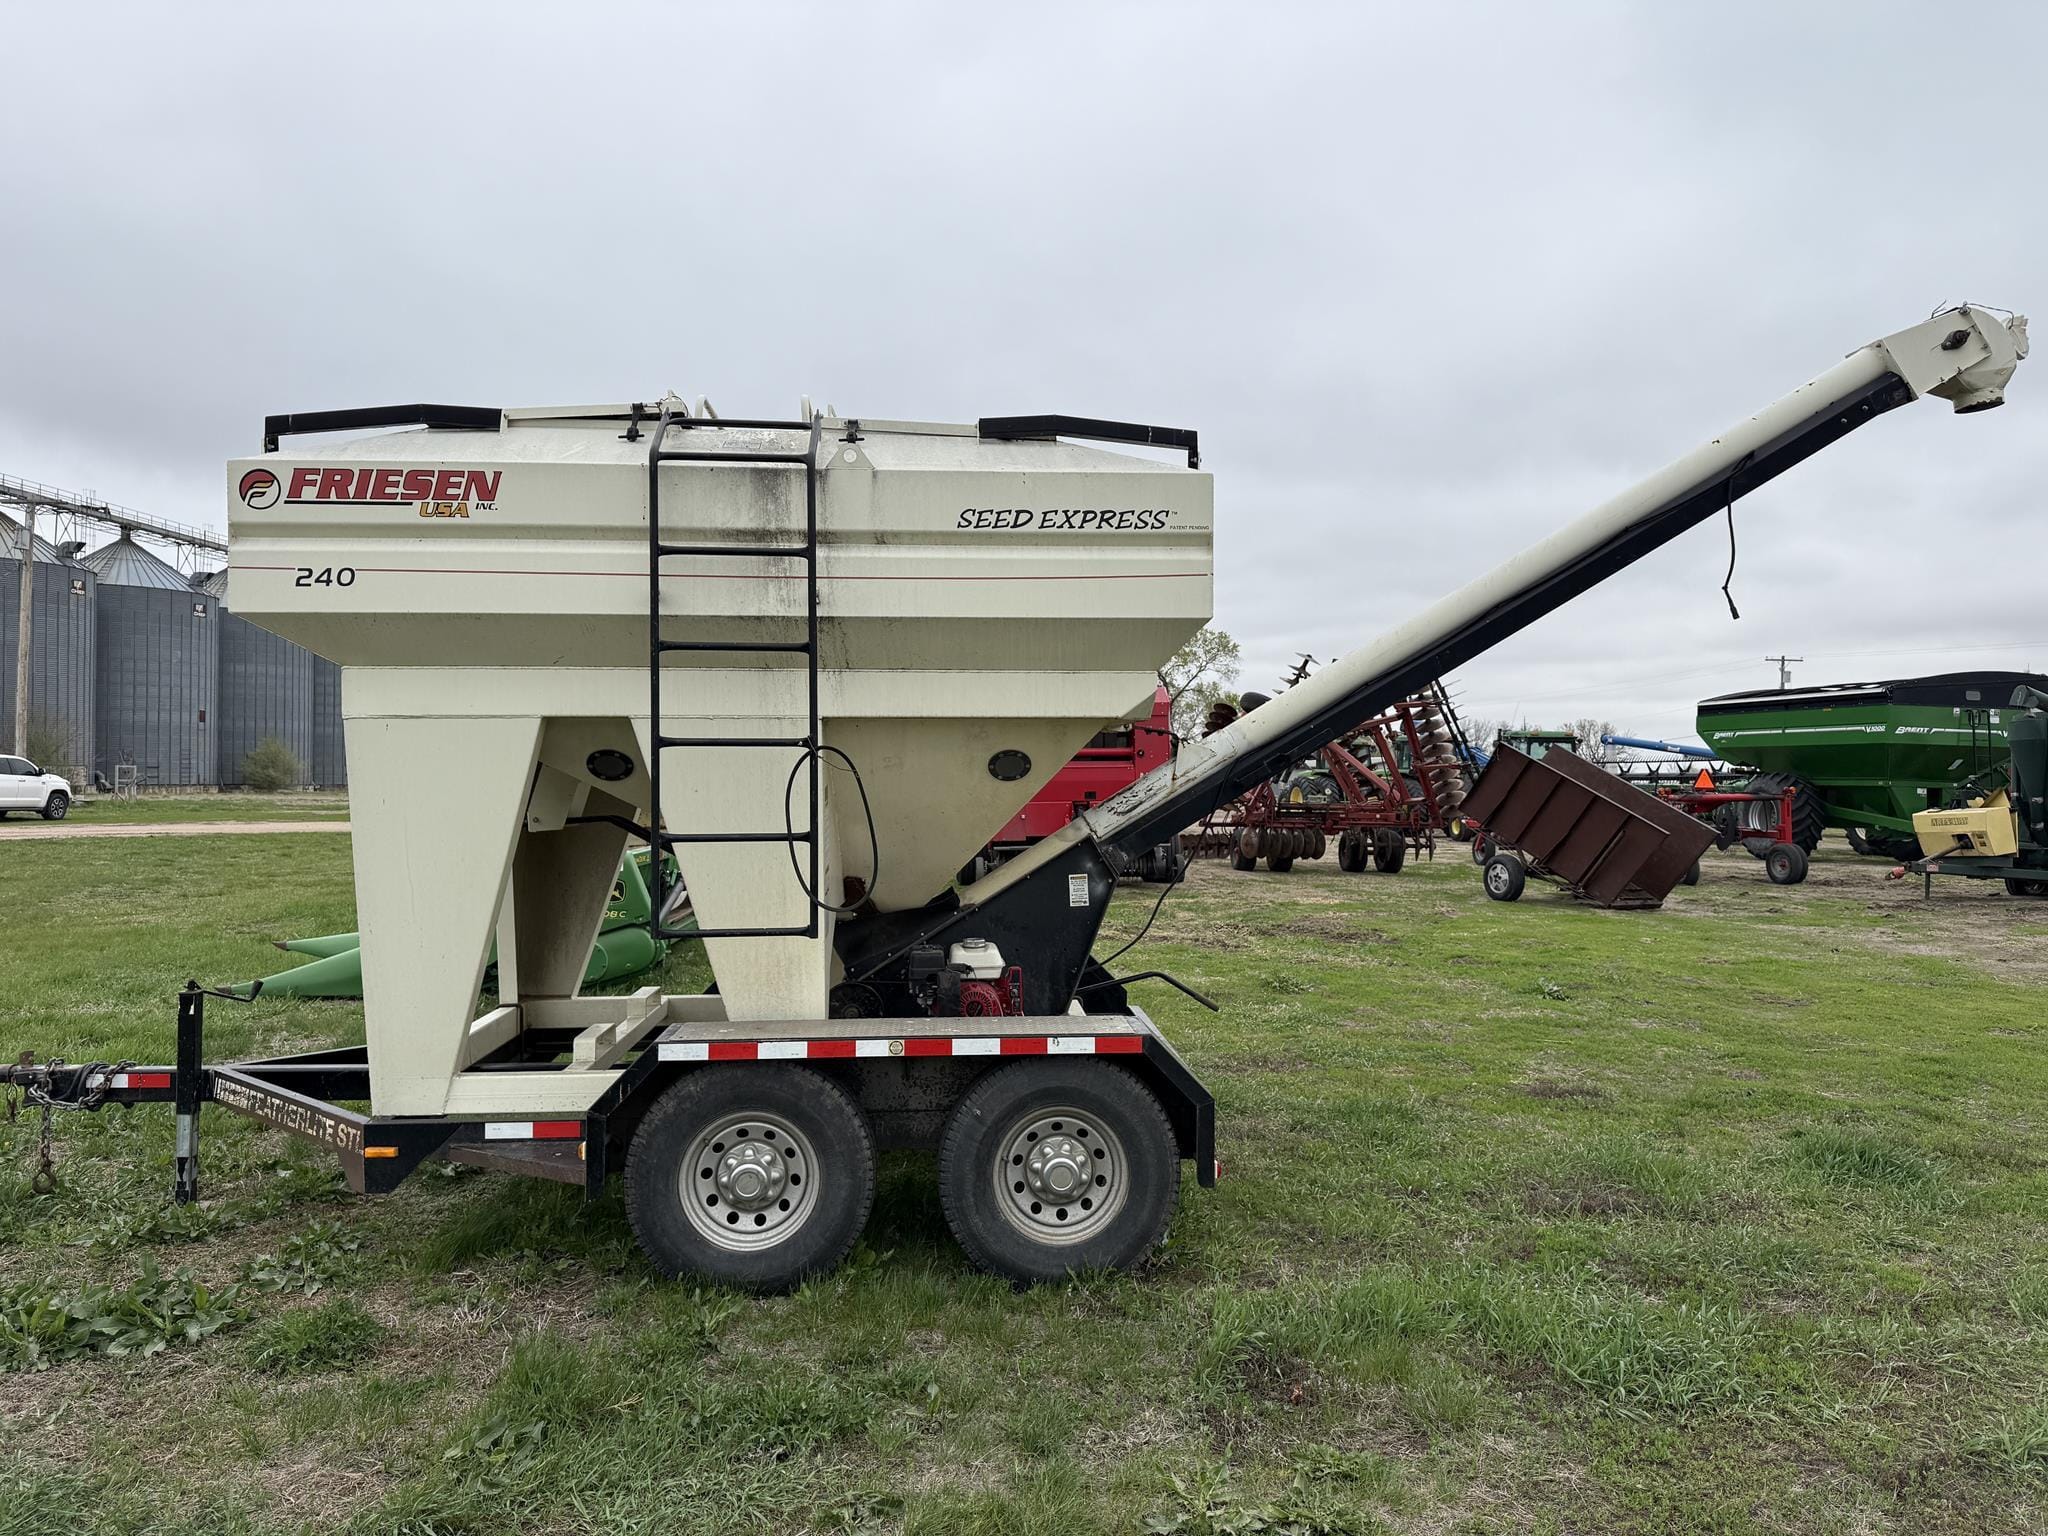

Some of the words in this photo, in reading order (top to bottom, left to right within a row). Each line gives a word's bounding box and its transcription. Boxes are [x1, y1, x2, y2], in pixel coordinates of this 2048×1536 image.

[286, 467, 502, 501] FRIESEN
[419, 501, 470, 518] USA
[475, 502, 498, 511] INC.
[957, 508, 1034, 529] SEED
[1038, 509, 1169, 530] EXPRESS
[295, 567, 356, 588] 240
[1895, 726, 1930, 734] BRENT
